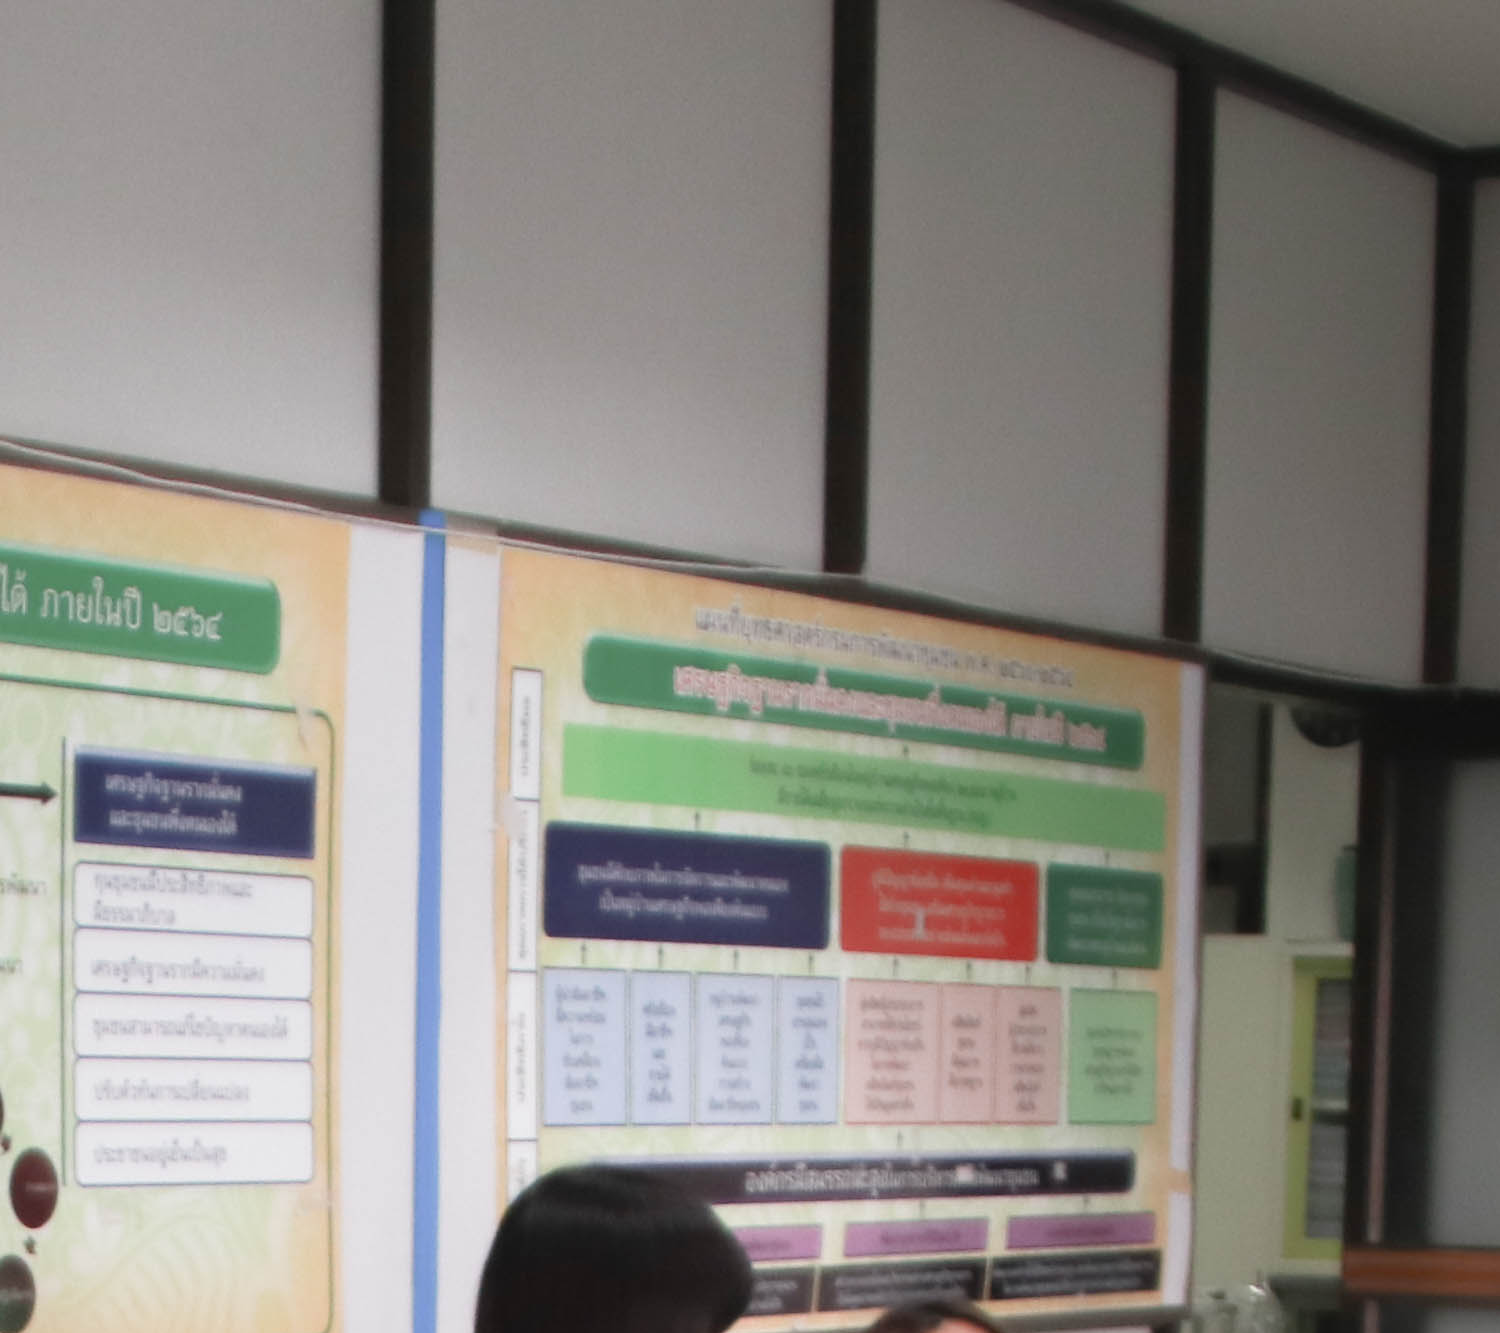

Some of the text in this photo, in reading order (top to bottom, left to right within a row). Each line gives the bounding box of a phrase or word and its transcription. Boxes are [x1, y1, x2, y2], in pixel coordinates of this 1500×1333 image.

[39, 576, 143, 630] ภายในปี
[152, 602, 224, 643] ๒๕๖๔
